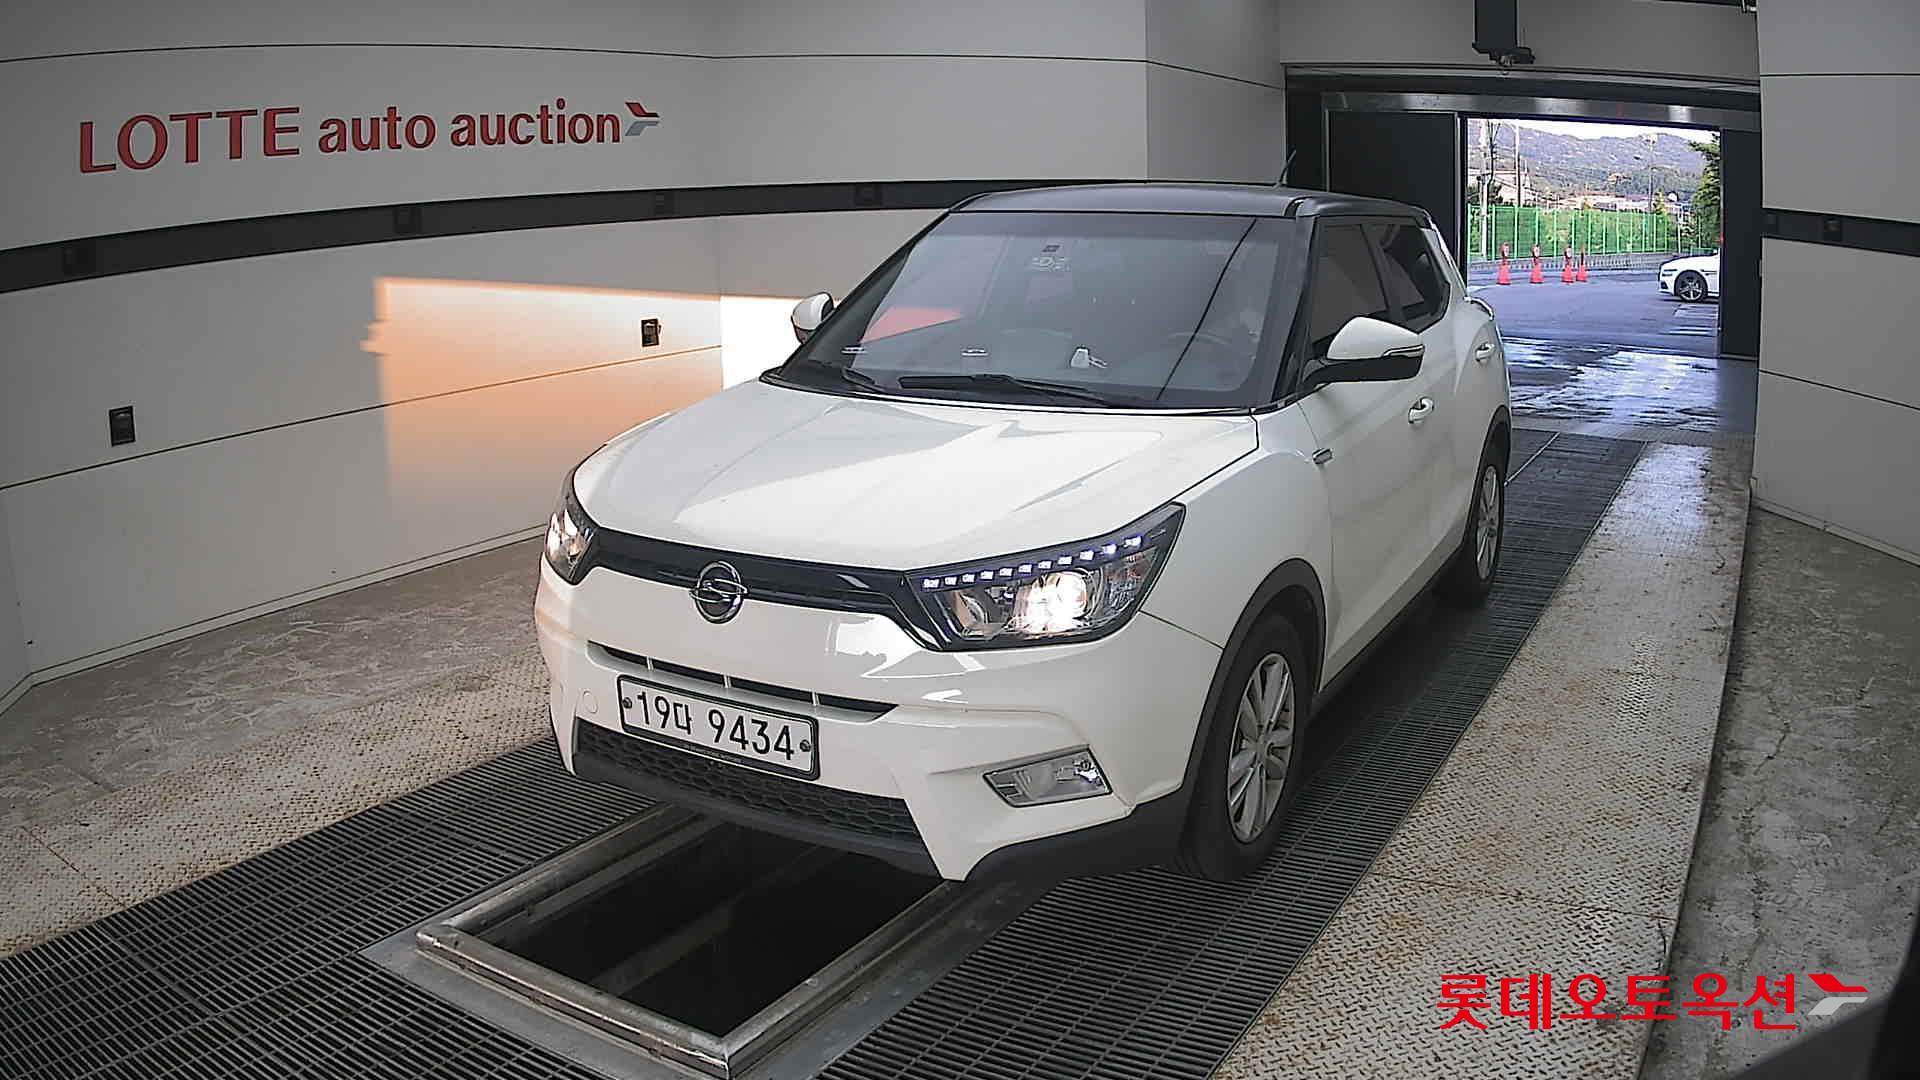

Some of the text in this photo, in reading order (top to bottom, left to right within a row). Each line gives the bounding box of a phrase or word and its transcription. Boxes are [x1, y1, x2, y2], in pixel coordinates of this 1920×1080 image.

[80, 98, 620, 173] LOTTE auto auction
[637, 691, 692, 735] 19다
[708, 709, 795, 761] 9434
